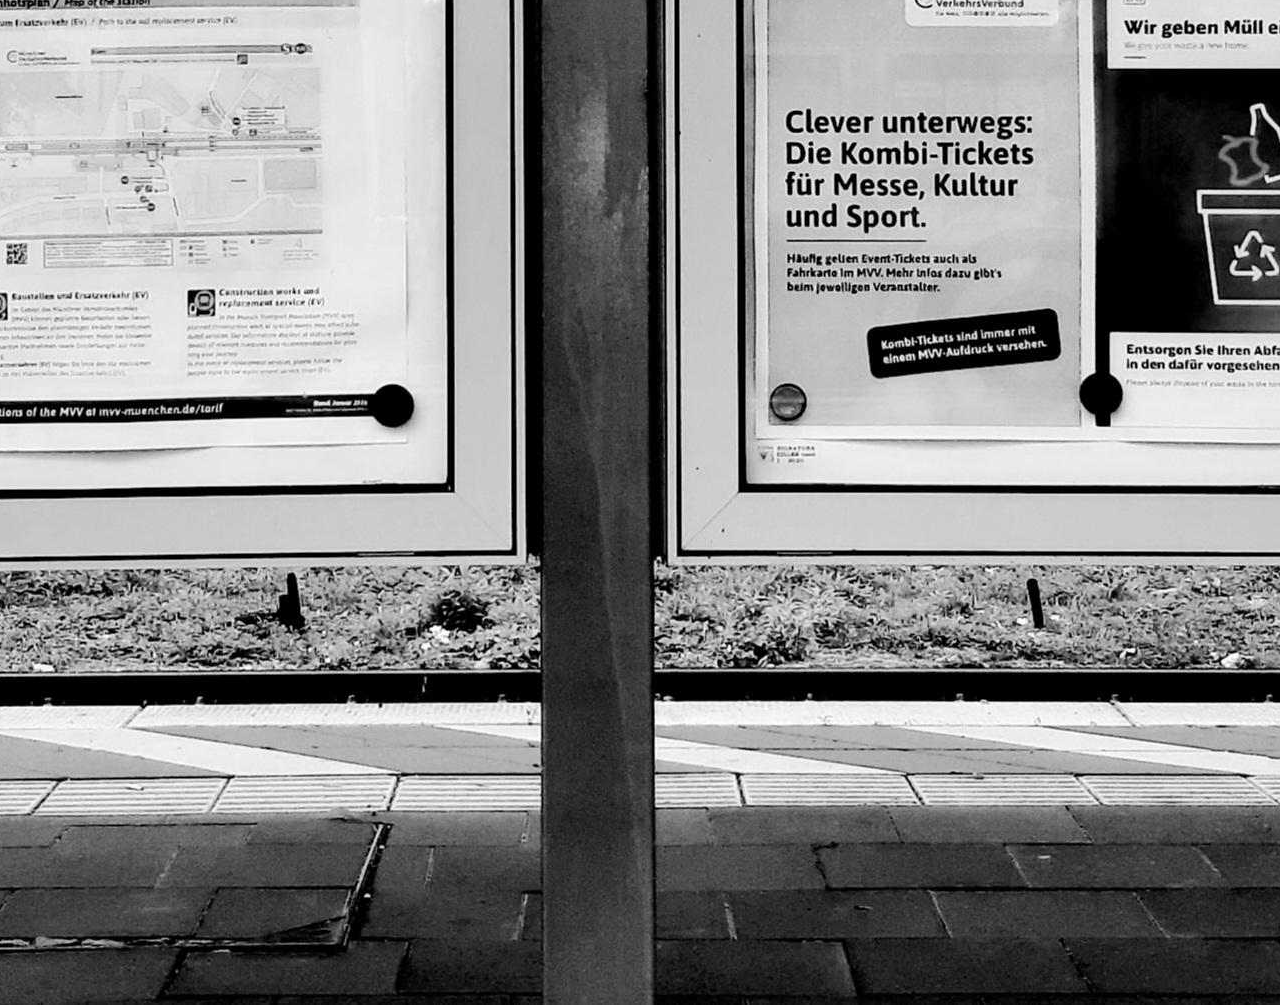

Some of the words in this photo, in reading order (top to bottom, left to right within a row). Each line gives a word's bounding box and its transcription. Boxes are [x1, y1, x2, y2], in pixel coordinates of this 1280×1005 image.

[1124, 20, 1158, 35] Wir
[1162, 20, 1219, 38] geben
[1224, 19, 1264, 35] Müll
[785, 109, 874, 133] Clever
[882, 111, 1033, 139] unterwegs:
[786, 141, 832, 165] Die
[840, 140, 1034, 165] Kombi-Tickets
[785, 171, 825, 196] für
[833, 172, 926, 200] Messe,
[933, 171, 1018, 196] Kultur
[786, 203, 838, 228] und
[846, 204, 927, 233] Sport.
[787, 253, 823, 266] Häufig
[825, 253, 859, 266] gelten
[862, 253, 931, 264] Event-Tickets
[933, 253, 959, 264] auch
[962, 253, 977, 264] als
[787, 268, 838, 278] Fahrkarte
[840, 268, 854, 278] im
[857, 268, 884, 278] MVV.
[886, 268, 914, 278] Mehr
[916, 267, 943, 278] Infos
[945, 267, 972, 278] dazu
[787, 281, 814, 293] beim
[816, 281, 870, 295] jeweiligen
[873, 281, 941, 293] Veranstalter.
[881, 333, 954, 350] Kombi-Tickets
[956, 330, 978, 343] sind
[981, 328, 1016, 340] immer
[1018, 325, 1036, 337] mit
[883, 351, 917, 365] einem
[918, 343, 994, 360] MVV-Aufdruck
[1126, 344, 1192, 359] Entsorgen
[1194, 344, 1214, 356] Sie
[1217, 344, 1251, 357] Ihren
[1126, 358, 1139, 370] in
[1141, 358, 1166, 370] den
[1169, 358, 1203, 371] dafür
[26, 406, 38, 417] of
[40, 406, 56, 417] the
[59, 406, 84, 417] MVV
[86, 407, 97, 417] at
